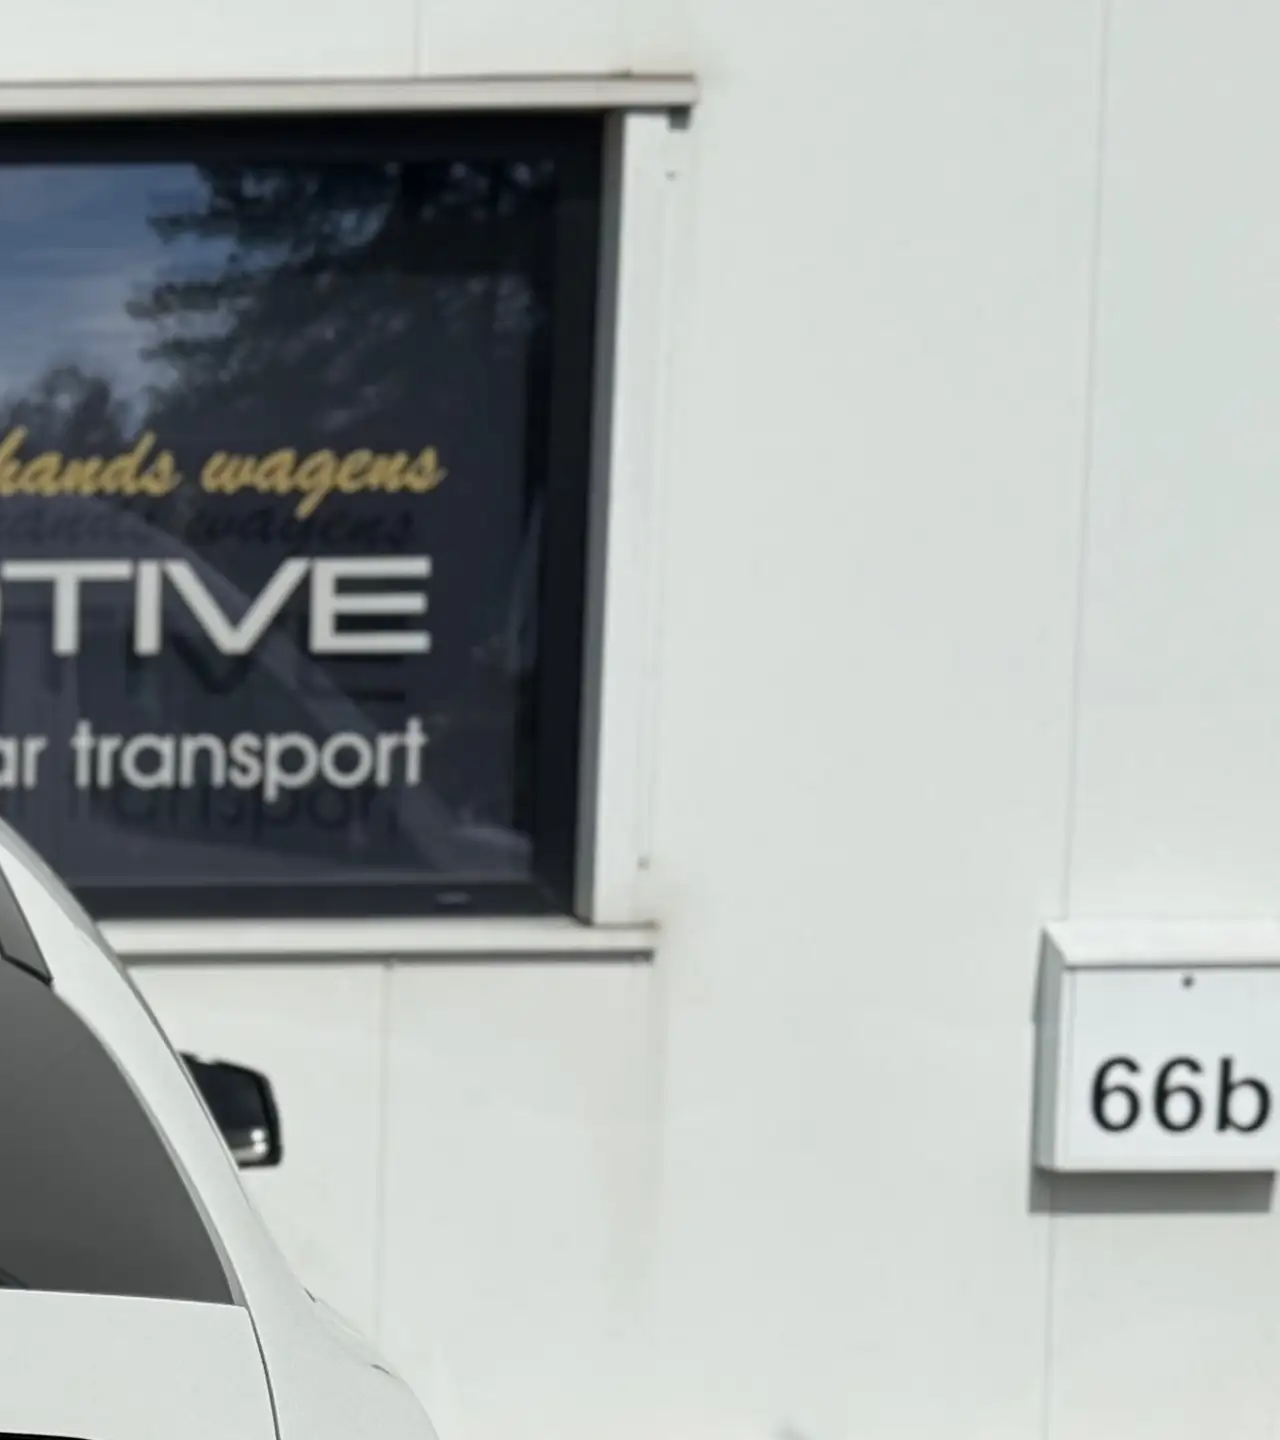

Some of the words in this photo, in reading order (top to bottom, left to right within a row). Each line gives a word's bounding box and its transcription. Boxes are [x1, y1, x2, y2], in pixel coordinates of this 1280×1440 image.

[200, 444, 446, 518] wagens
[70, 716, 428, 803] transport
[1091, 1055, 1273, 1135] 66b
